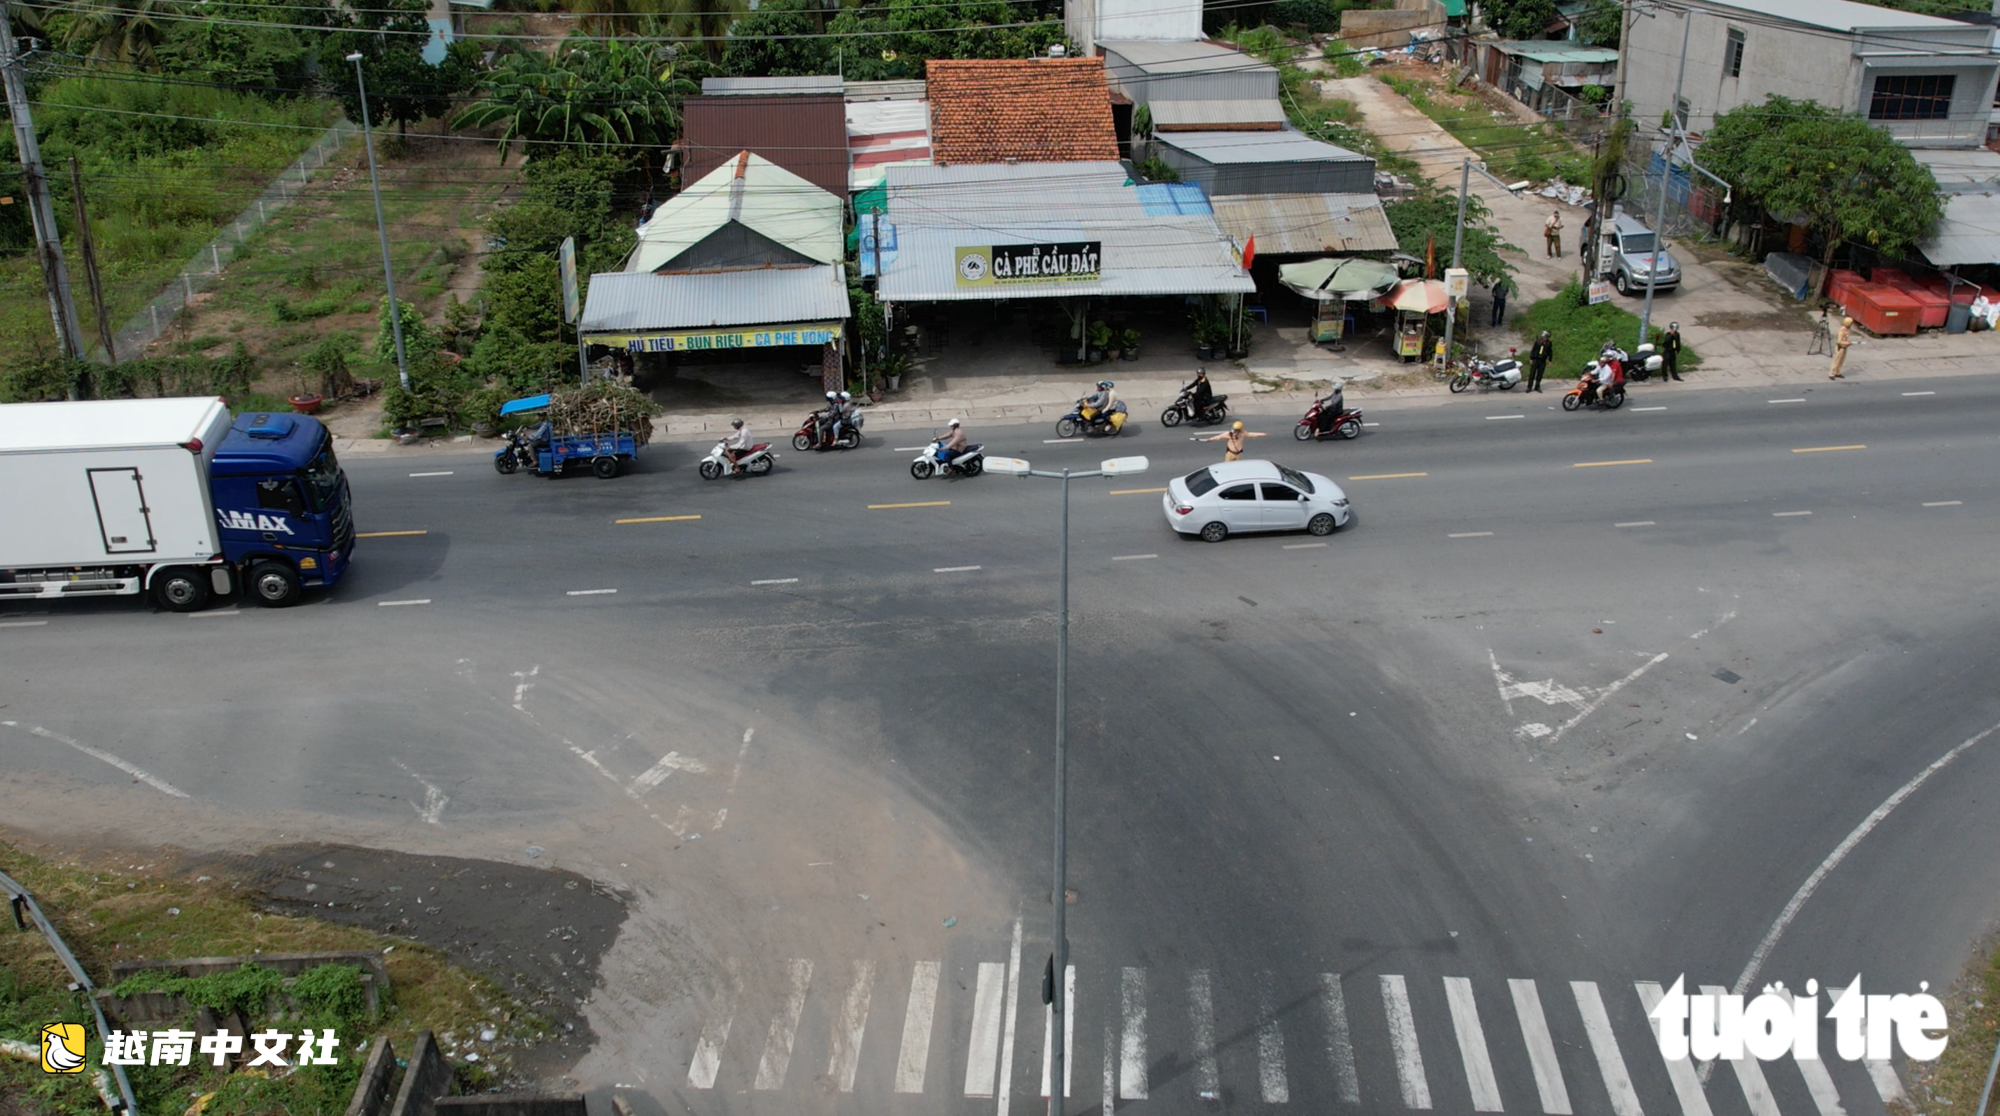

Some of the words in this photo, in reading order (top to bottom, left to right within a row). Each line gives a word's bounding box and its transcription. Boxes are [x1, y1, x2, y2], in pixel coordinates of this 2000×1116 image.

[994, 251, 1012, 276] CÀ
[1042, 245, 1068, 274] CẦU
[1071, 245, 1098, 273] ĐẤT
